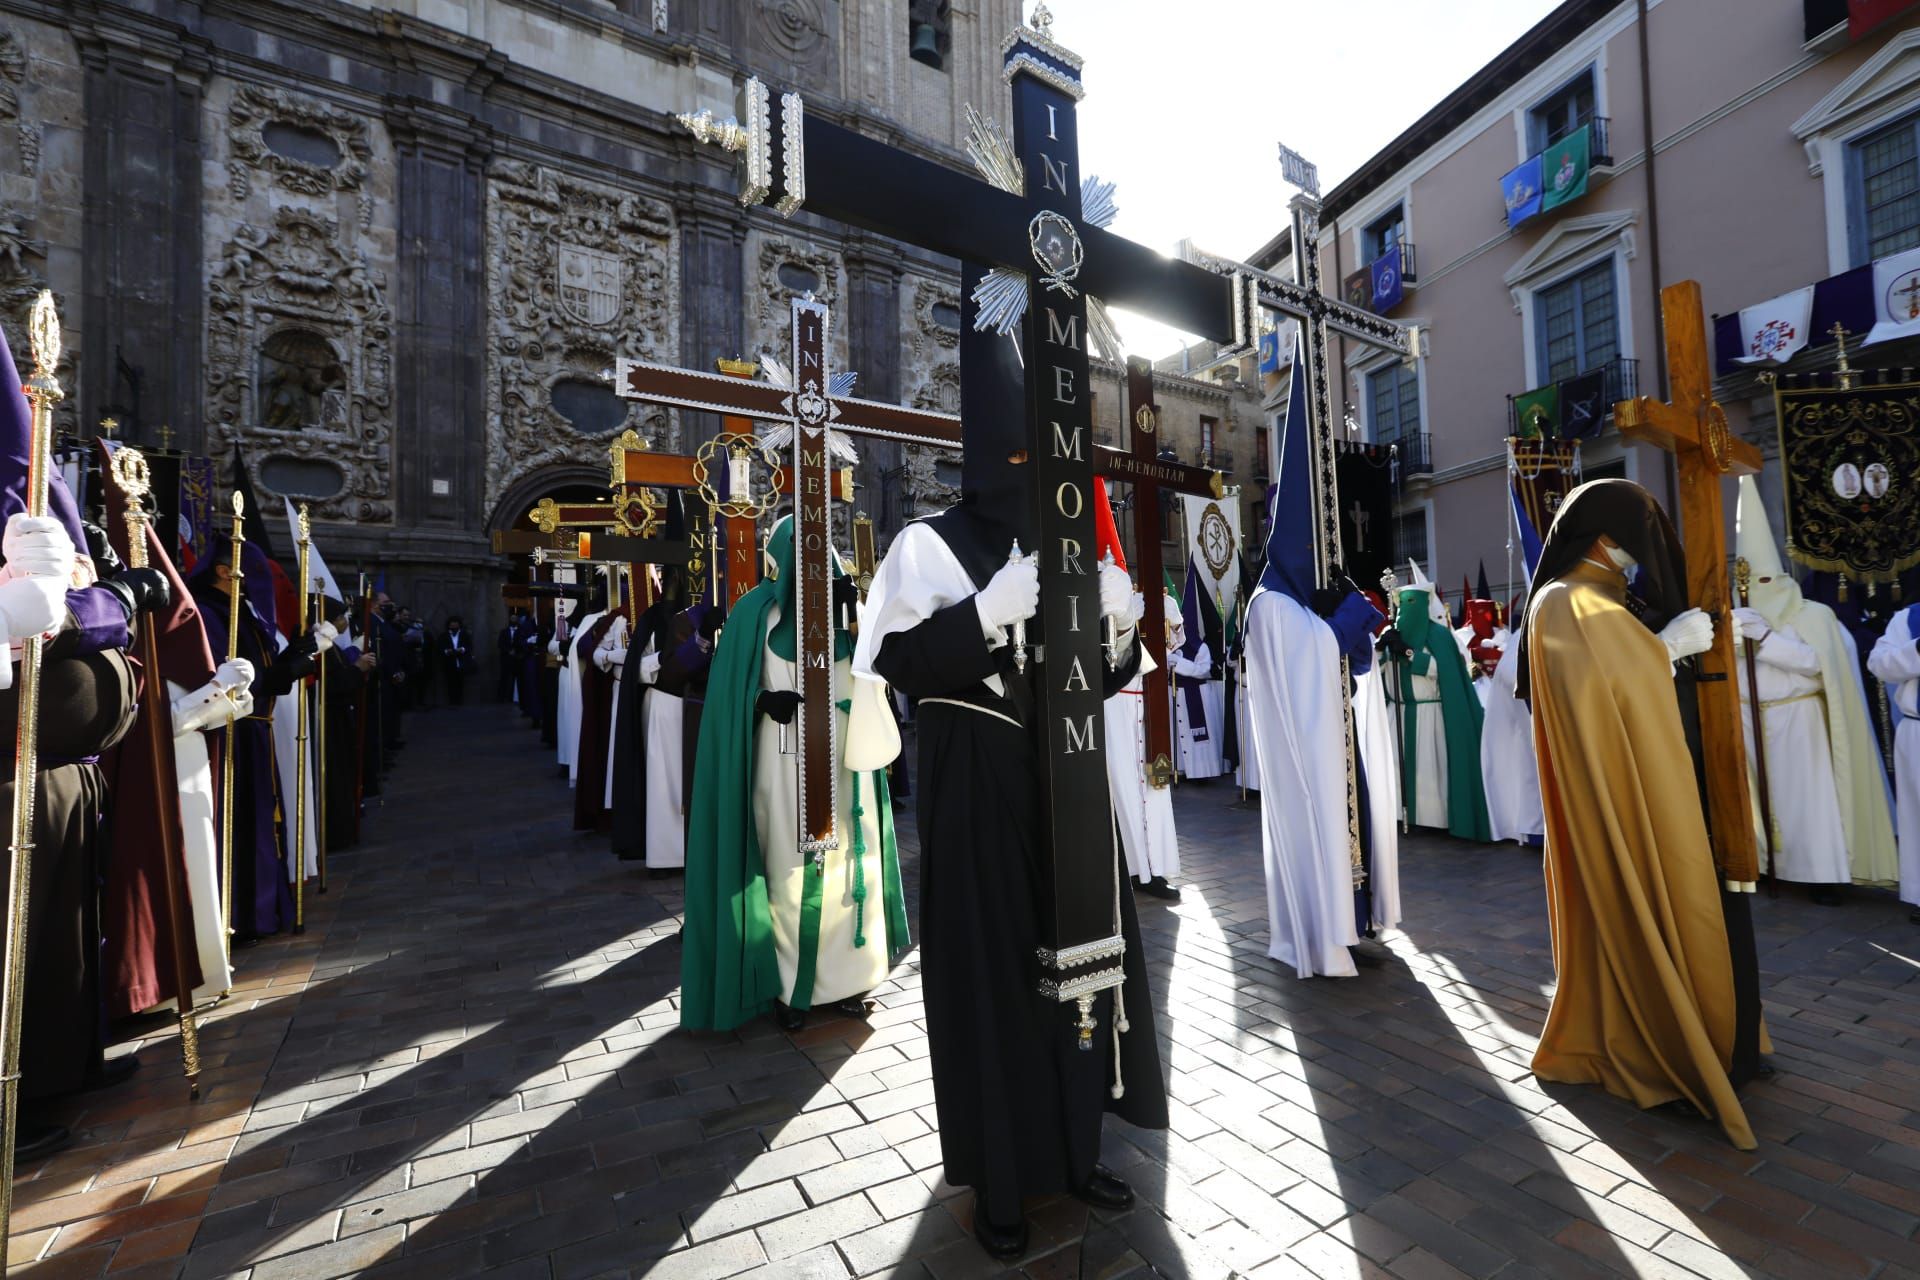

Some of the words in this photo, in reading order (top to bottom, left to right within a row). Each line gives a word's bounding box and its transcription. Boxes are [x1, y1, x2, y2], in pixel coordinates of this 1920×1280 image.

[1040, 103, 1069, 197] IN
[803, 325, 819, 369] IN
[688, 515, 705, 550] IN
[736, 530, 747, 563] IN
[802, 449, 829, 669] MEMORIAM
[1045, 306, 1099, 754] MEMORIAM
